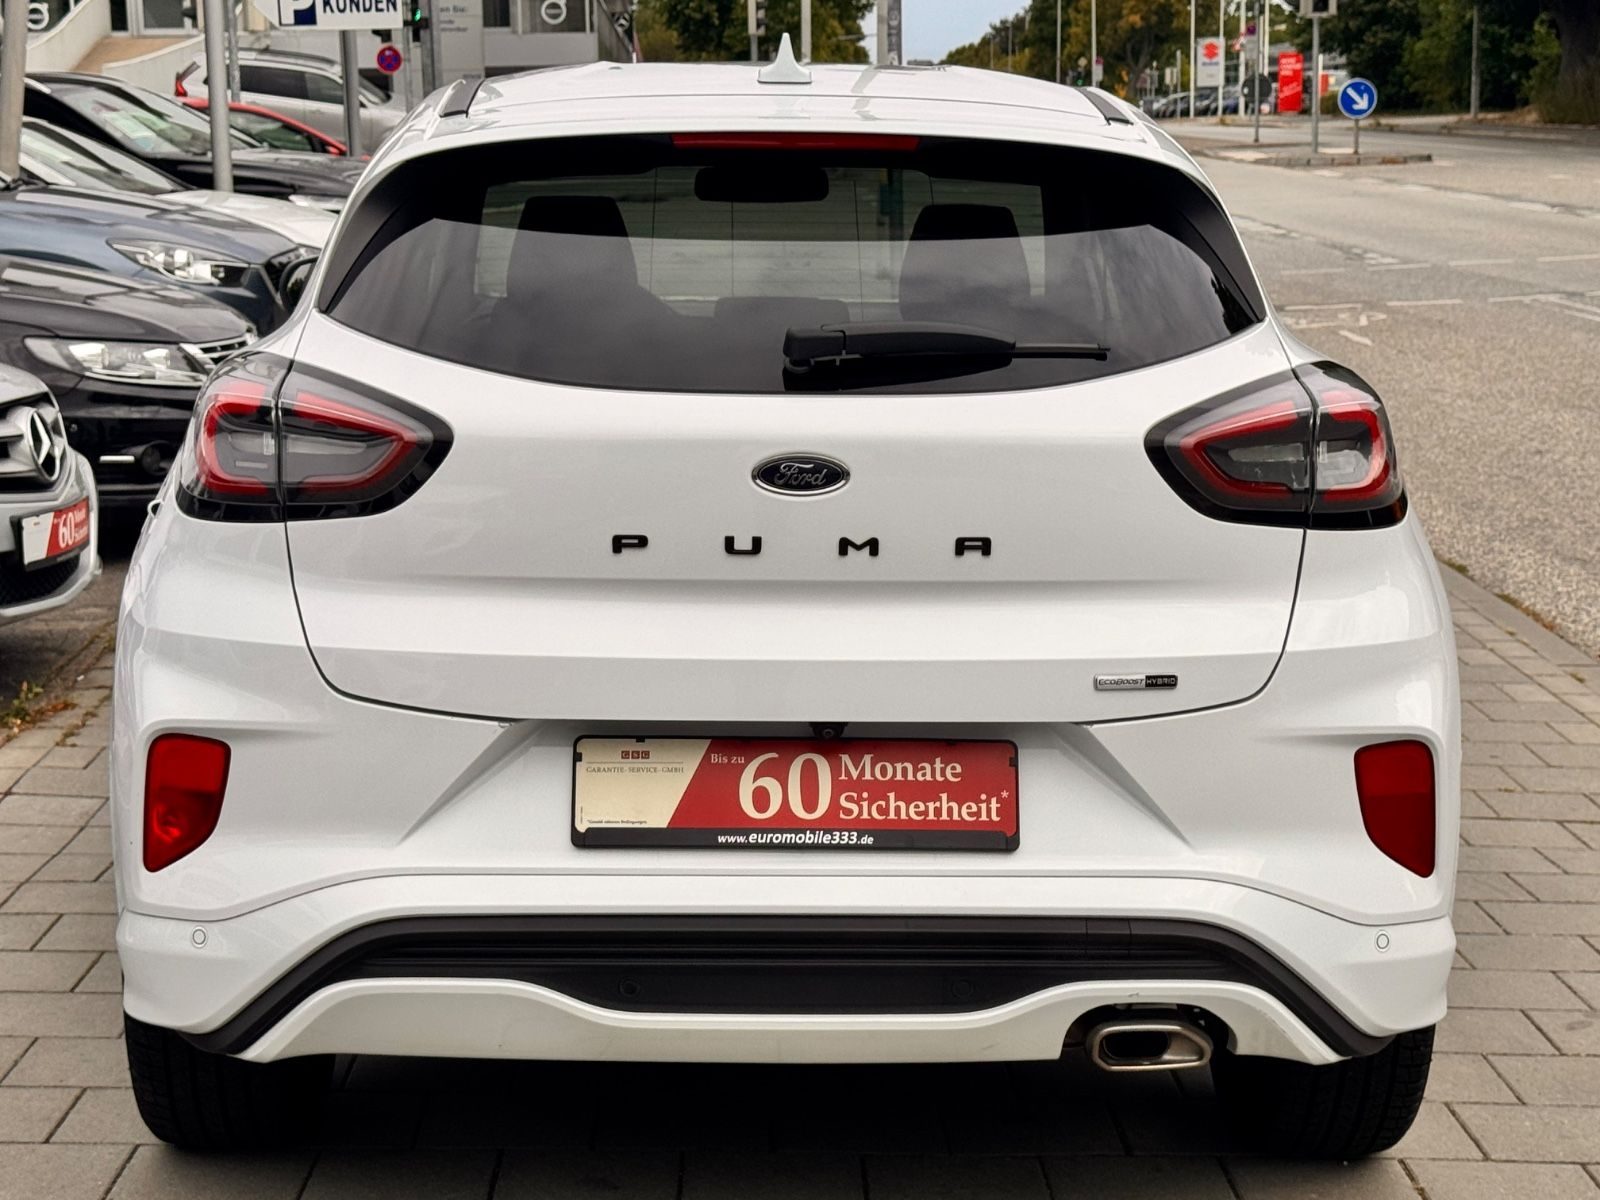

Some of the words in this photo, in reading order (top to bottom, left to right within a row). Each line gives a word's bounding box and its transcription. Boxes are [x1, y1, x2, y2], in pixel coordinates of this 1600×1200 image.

[774, 462, 828, 486] Ford
[58, 511, 75, 549] 60
[611, 534, 992, 557] PUMA
[1146, 677, 1176, 685] HYBRID
[710, 753, 728, 764] Bis
[731, 754, 745, 764] zu
[838, 753, 963, 782] Monate
[738, 752, 832, 820] 60
[717, 830, 875, 845] www.euromobile333.de
